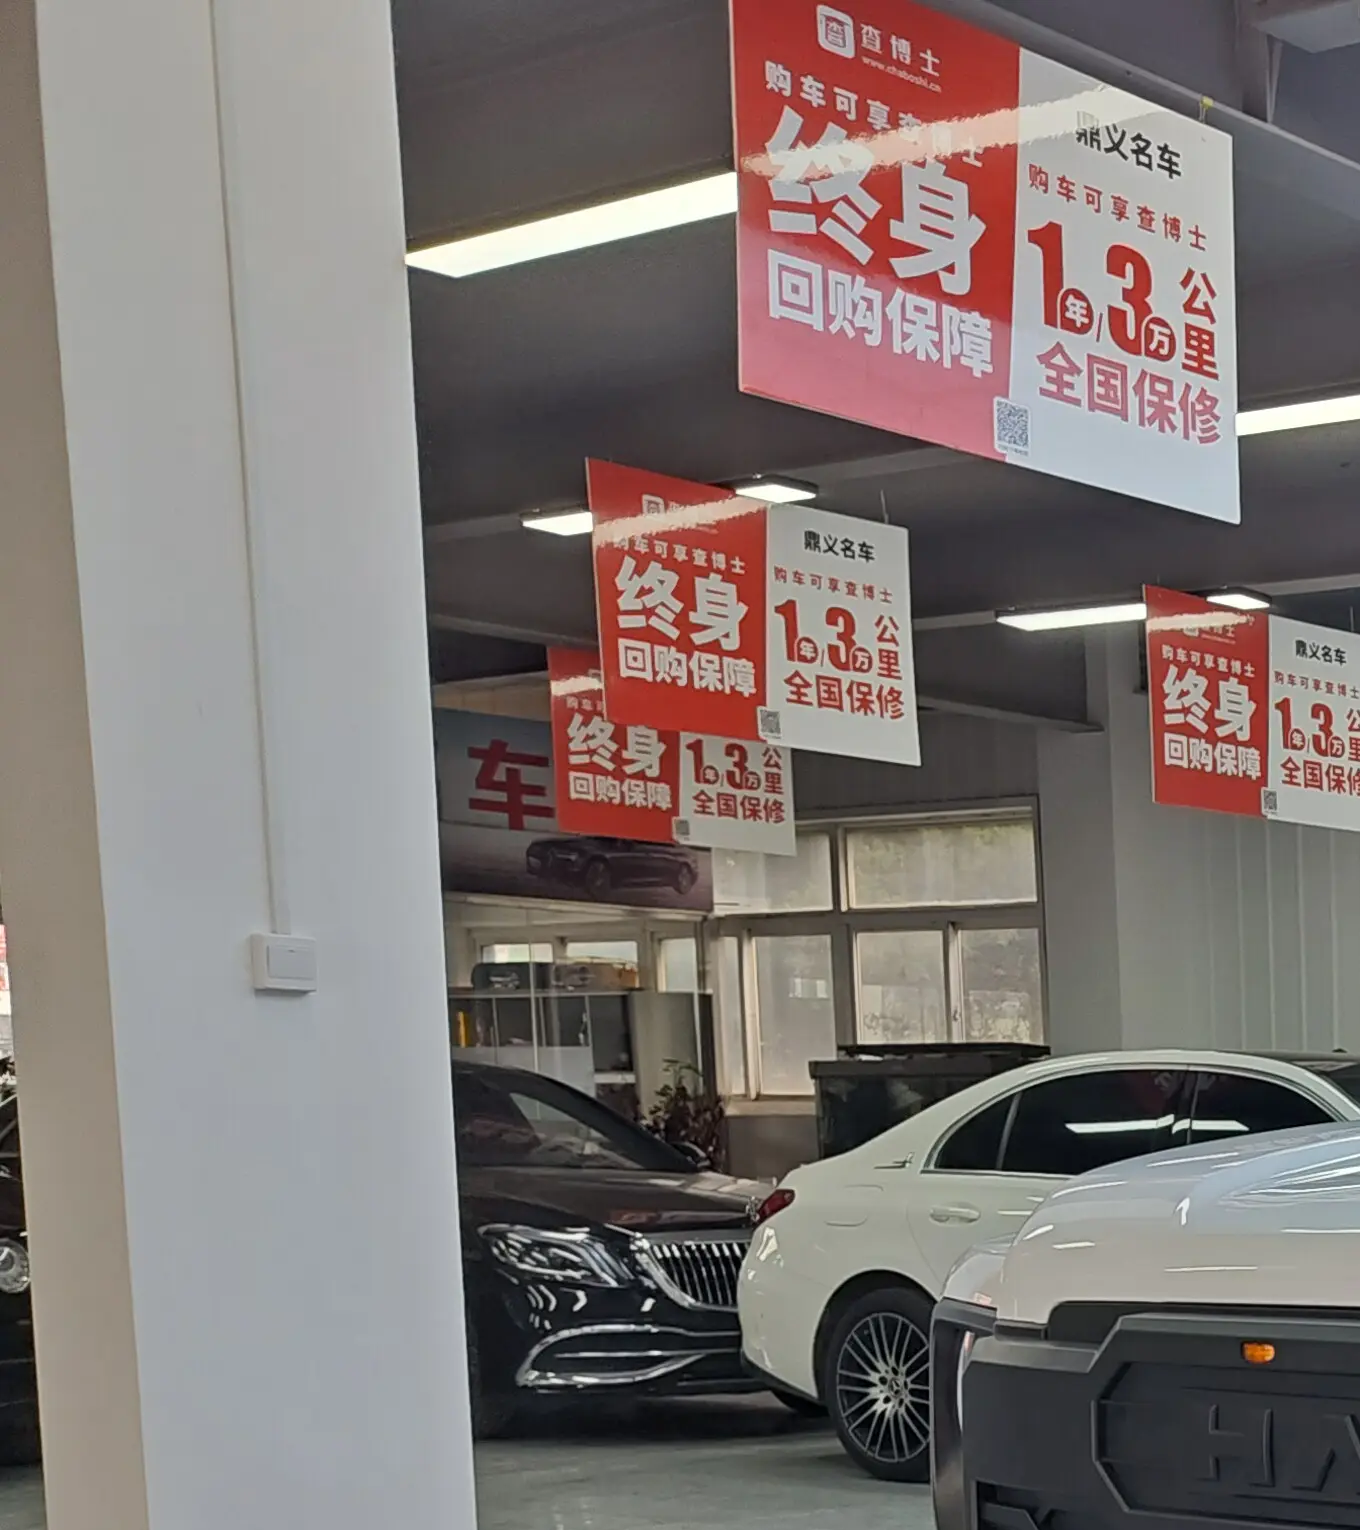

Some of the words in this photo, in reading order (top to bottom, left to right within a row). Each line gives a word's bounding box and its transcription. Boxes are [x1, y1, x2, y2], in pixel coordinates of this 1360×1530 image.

[860, 23, 941, 77] 查博士
[1076, 110, 1182, 180] 鼎义名车
[764, 104, 987, 297] 终身
[1028, 164, 1207, 252] 购车可享查博士
[767, 248, 994, 379] 回购保障
[1036, 342, 1221, 445] 全国保修
[804, 529, 875, 563] 鼎义名车
[615, 555, 748, 652] 终身
[773, 566, 893, 603] 购车可享查博士
[617, 638, 757, 698] 回购保障
[783, 670, 905, 720] 全国保修
[1163, 664, 1257, 741] 终身
[567, 713, 667, 778] 终身
[1164, 732, 1262, 780] 回购保障
[569, 771, 672, 811] 回购保障
[693, 791, 785, 824] 全国保修
